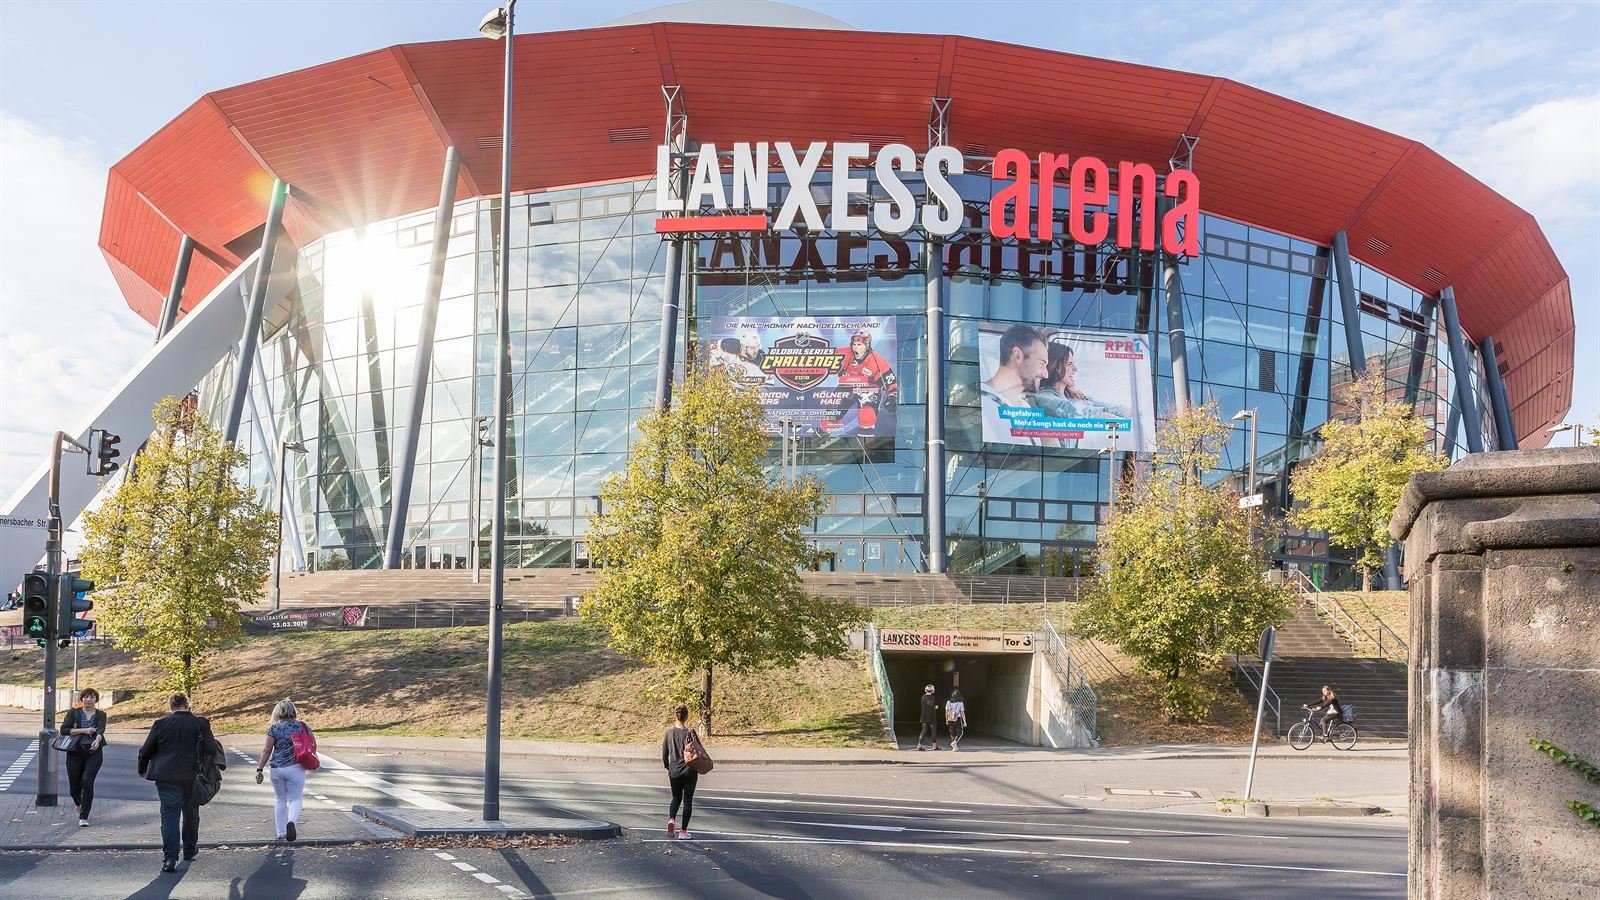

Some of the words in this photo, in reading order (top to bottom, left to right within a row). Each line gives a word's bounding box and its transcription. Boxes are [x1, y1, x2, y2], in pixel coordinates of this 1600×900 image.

[656, 141, 964, 236] LANXESS
[990, 148, 1201, 257] arena
[761, 355, 843, 370] CHALLENGE
[813, 390, 850, 398] KÖLNER
[1002, 409, 1042, 418] Abgefahren:
[36, 518, 48, 528] Str.
[272, 620, 307, 628] 25.03.2019
[882, 633, 921, 646] LANXESS
[922, 634, 951, 647] arena
[1004, 638, 1020, 646] Tor
[1022, 634, 1032, 646] 3
